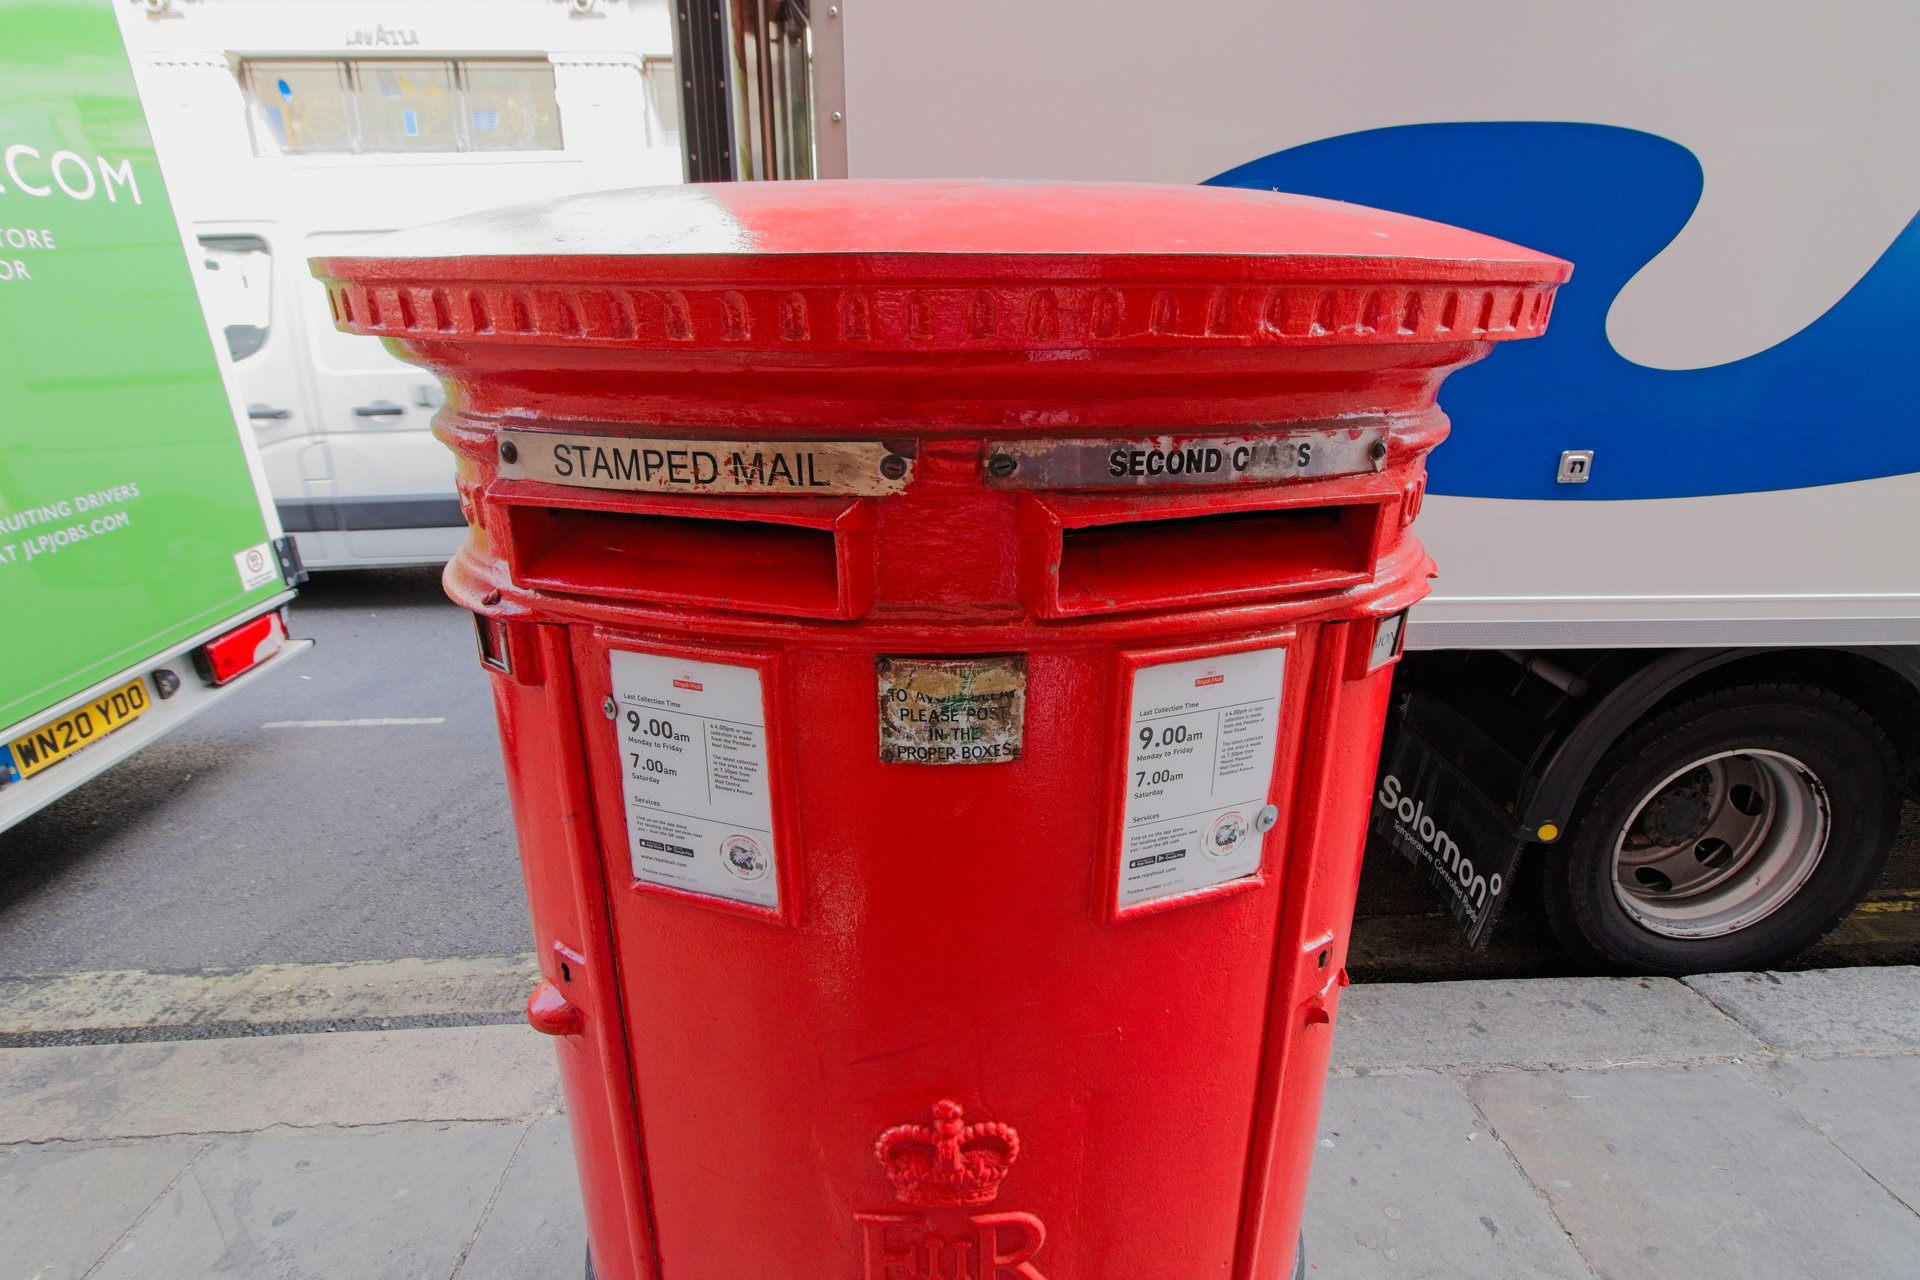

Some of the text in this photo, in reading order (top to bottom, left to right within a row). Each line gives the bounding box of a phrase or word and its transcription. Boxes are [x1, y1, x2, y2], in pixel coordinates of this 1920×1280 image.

[554, 443, 831, 487] STAMPED MAIL
[1109, 448, 1223, 477] SECOND
[74, 482, 140, 513] DRIVERS
[21, 511, 130, 561] JLPJOBS.COM
[624, 692, 681, 708] Last Collection Time
[888, 688, 908, 702] TO
[900, 706, 1009, 722] PLEASE POST
[1139, 709, 1153, 717] Last
[1154, 704, 1183, 715] Collection
[627, 710, 690, 743] 9.00am
[929, 727, 980, 741] IN THE
[15, 711, 94, 769] WN20
[628, 736, 683, 754] Monday to Friday
[1139, 725, 1203, 750] 9.00am
[897, 742, 1012, 760] PROPER BOXES
[1136, 752, 1162, 762] Monday
[1173, 747, 1194, 755] Friday
[629, 752, 678, 776] 7.00am
[631, 772, 660, 785] Saturday
[1135, 769, 1184, 788] 7.00am
[634, 796, 661, 807] Services
[1134, 788, 1164, 800] Saturday
[1132, 813, 1160, 824] Services
[1393, 819, 1433, 862] Temperature
[1434, 858, 1463, 898] Controlled
